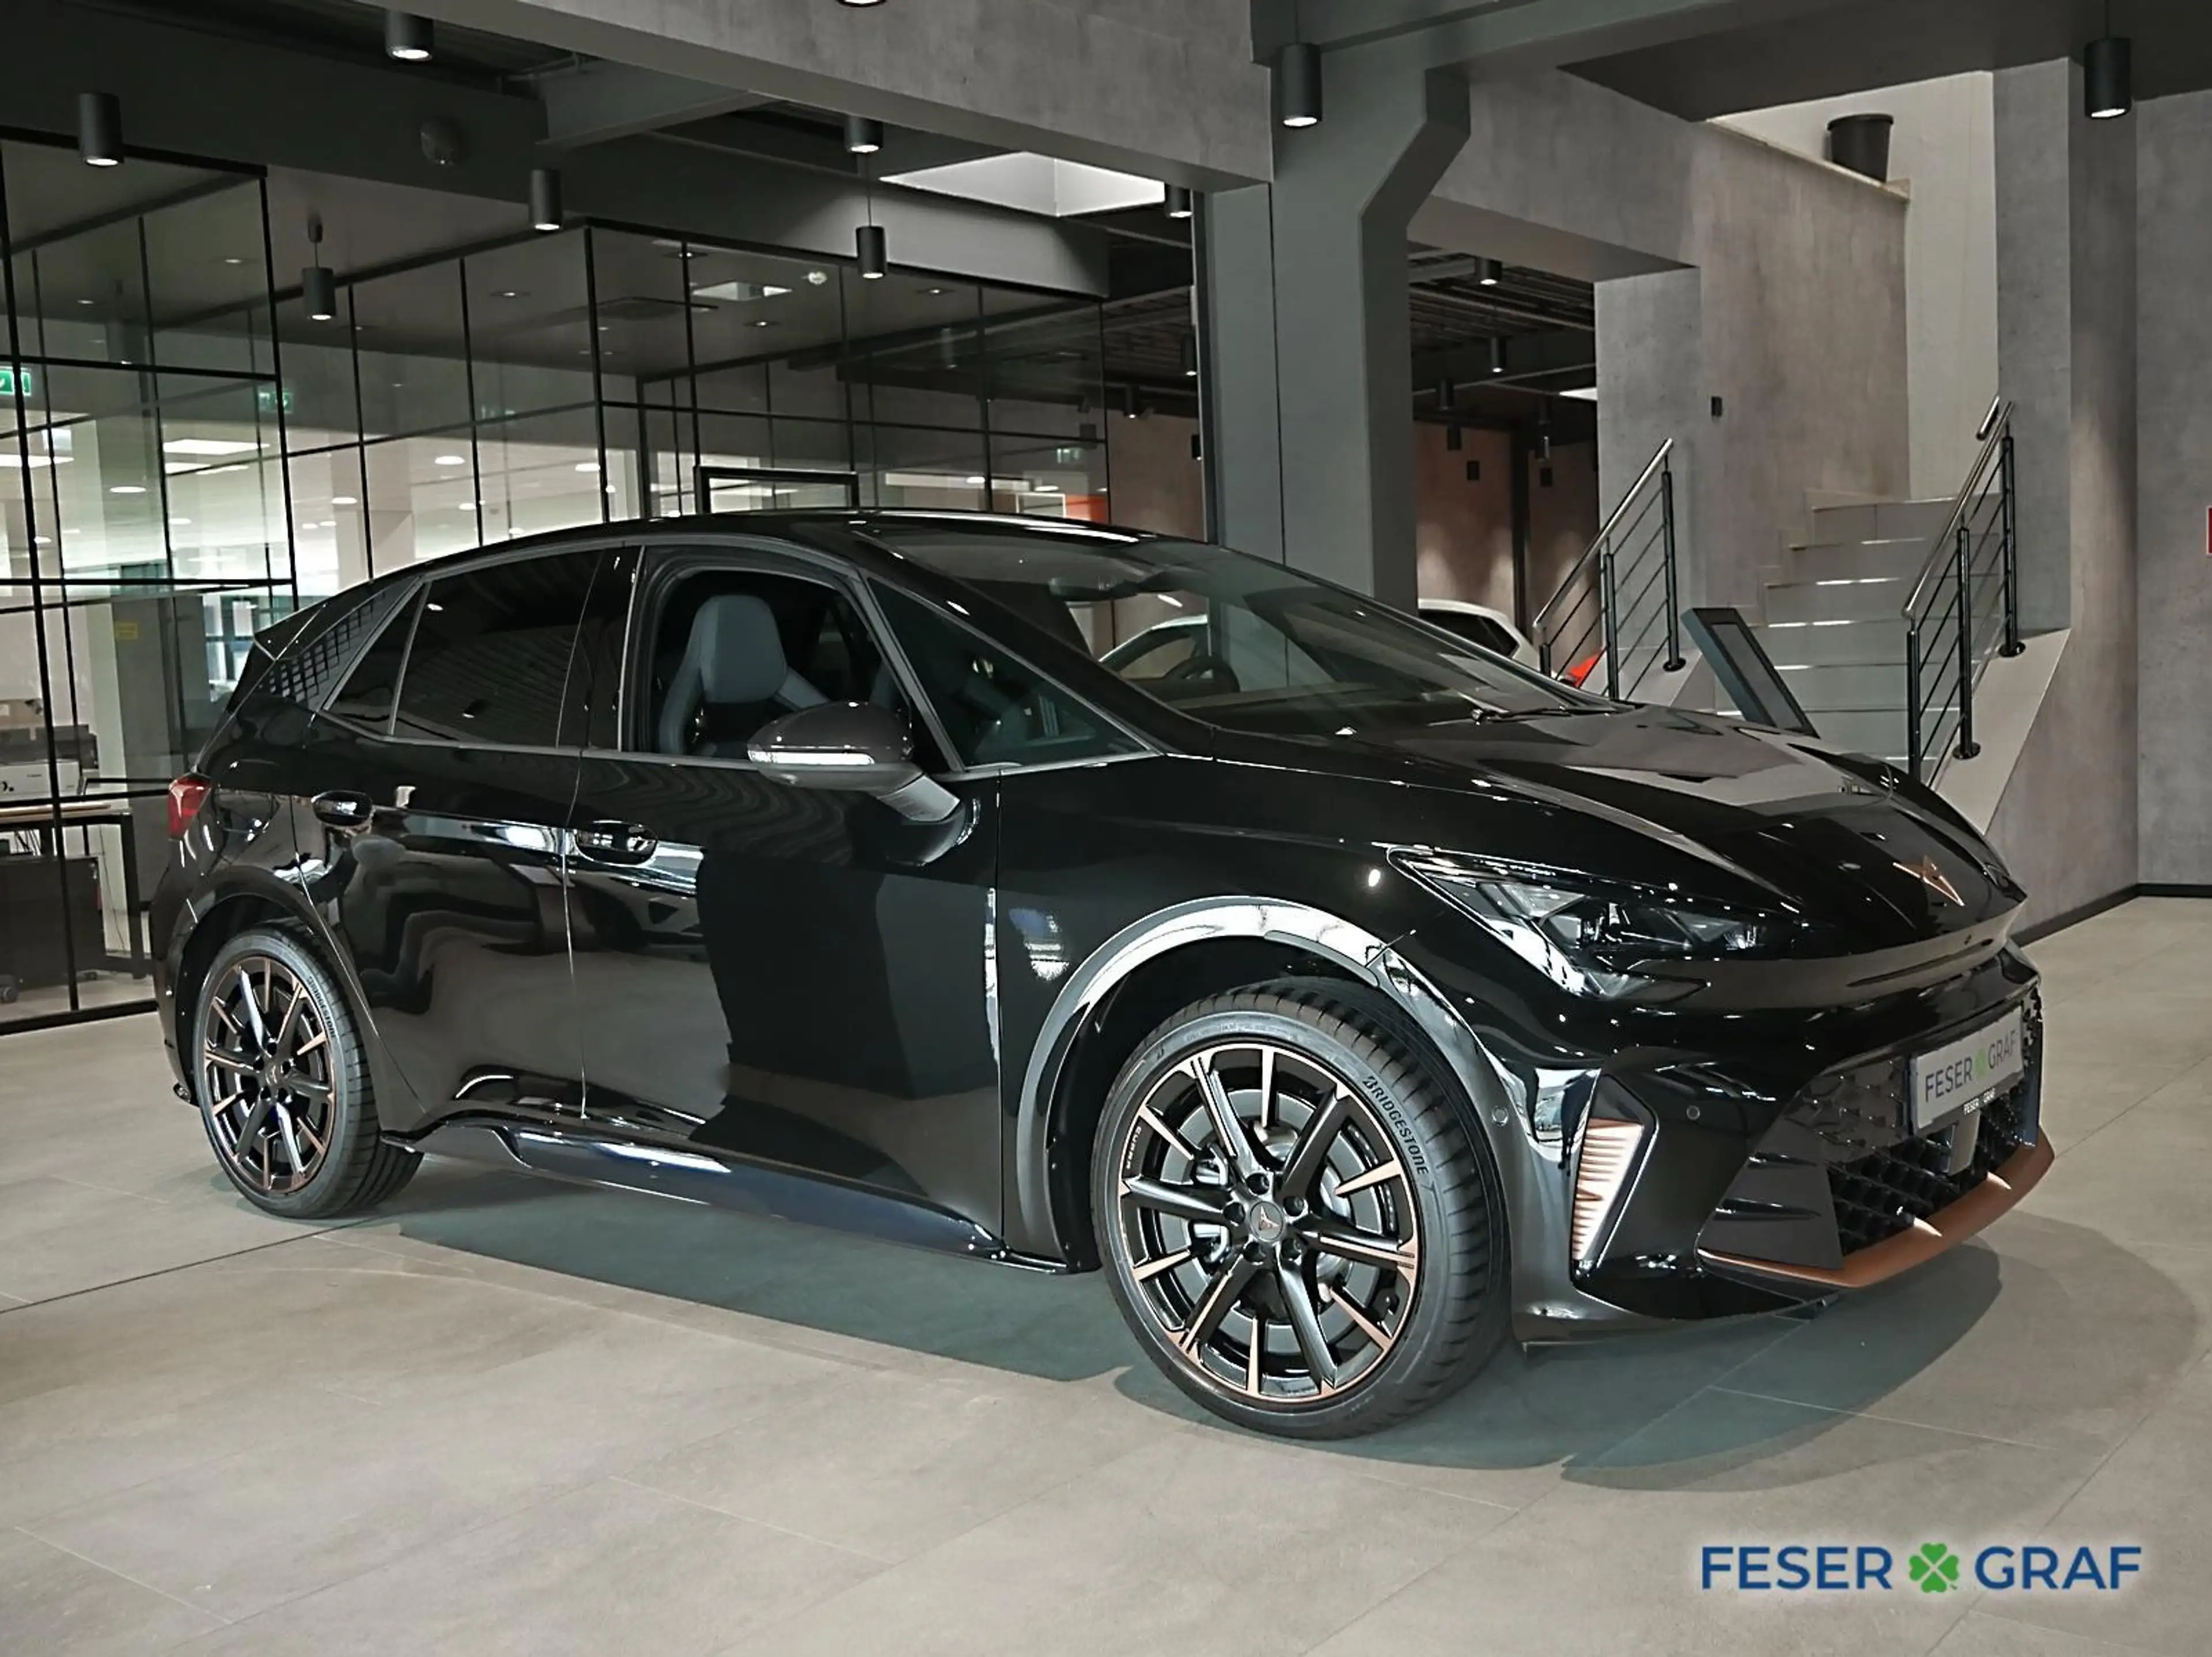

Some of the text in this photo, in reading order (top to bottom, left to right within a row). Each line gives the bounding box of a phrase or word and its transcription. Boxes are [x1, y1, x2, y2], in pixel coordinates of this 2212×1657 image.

[1926, 1029, 2016, 1102] FESER GRAF
[1362, 1075, 1429, 1175] BRIDGESTONE
